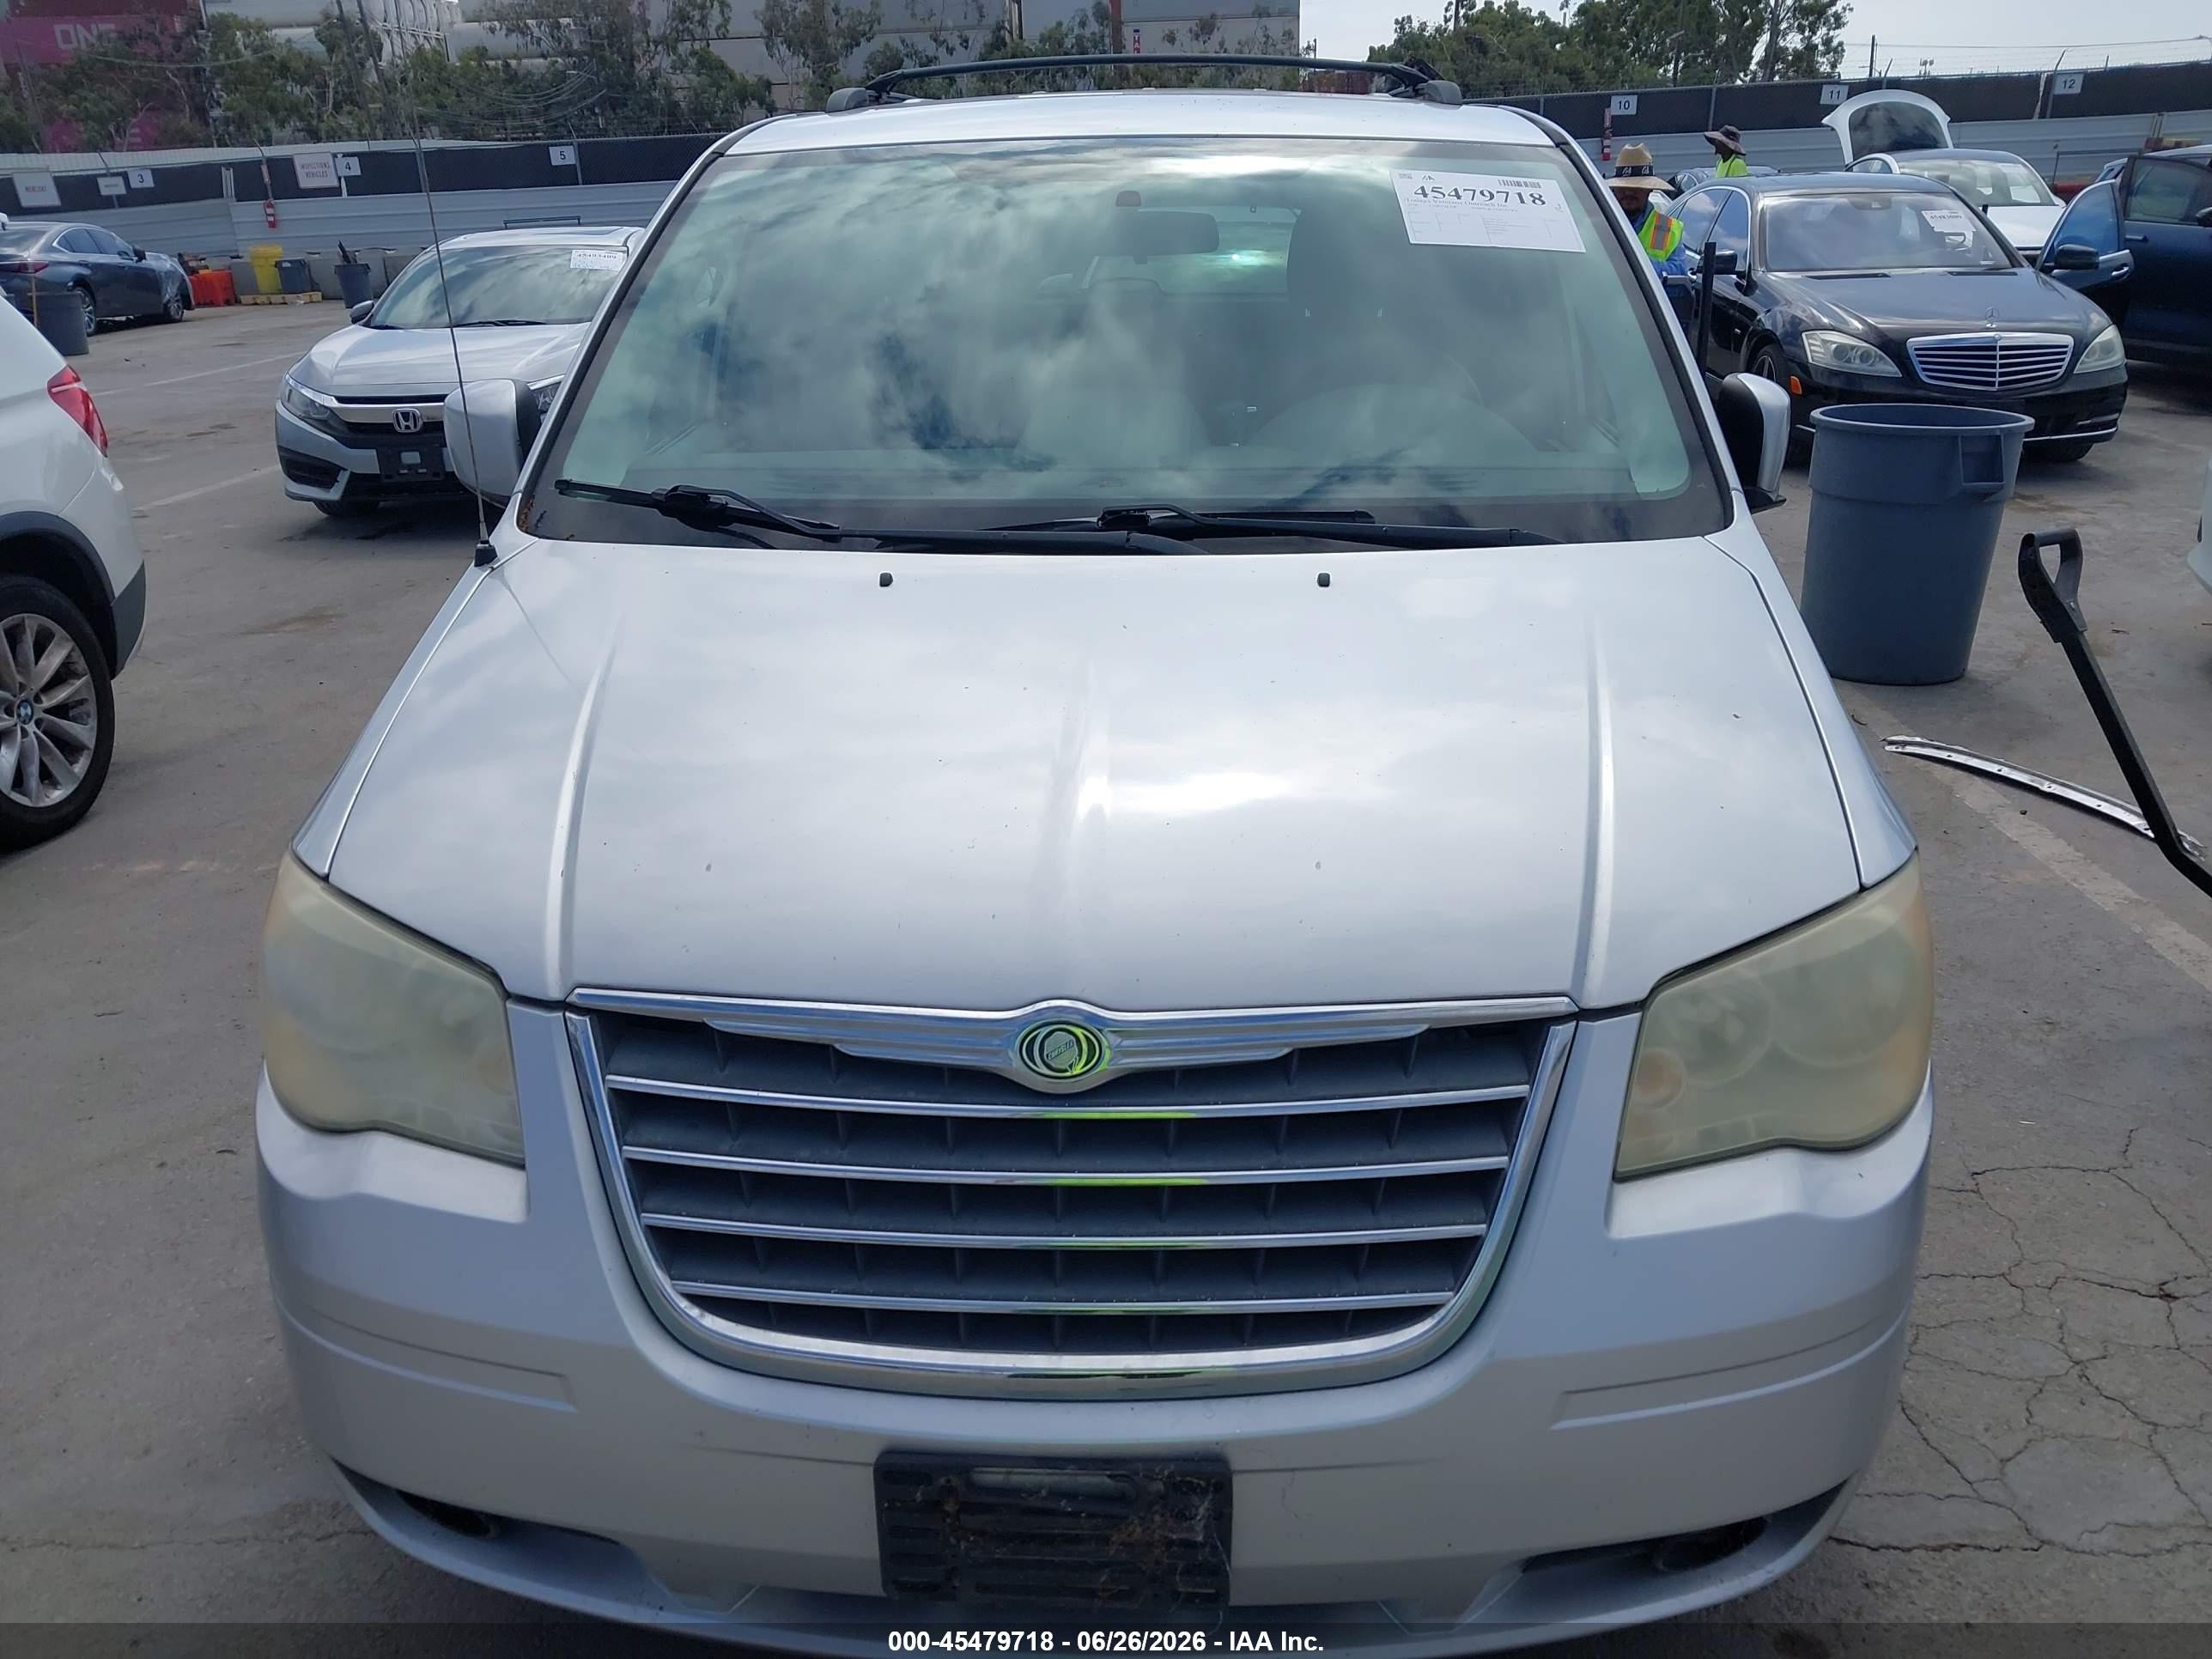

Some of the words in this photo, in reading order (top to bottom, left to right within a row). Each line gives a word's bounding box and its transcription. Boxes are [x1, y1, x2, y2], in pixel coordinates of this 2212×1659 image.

[2063, 78, 2075, 89] 12
[1829, 89, 1841, 100] 11
[1618, 100, 1631, 111] 10
[559, 150, 567, 161] 5
[344, 161, 351, 172] 4
[137, 173, 144, 184] 3
[1413, 185, 1547, 206] 45479718
